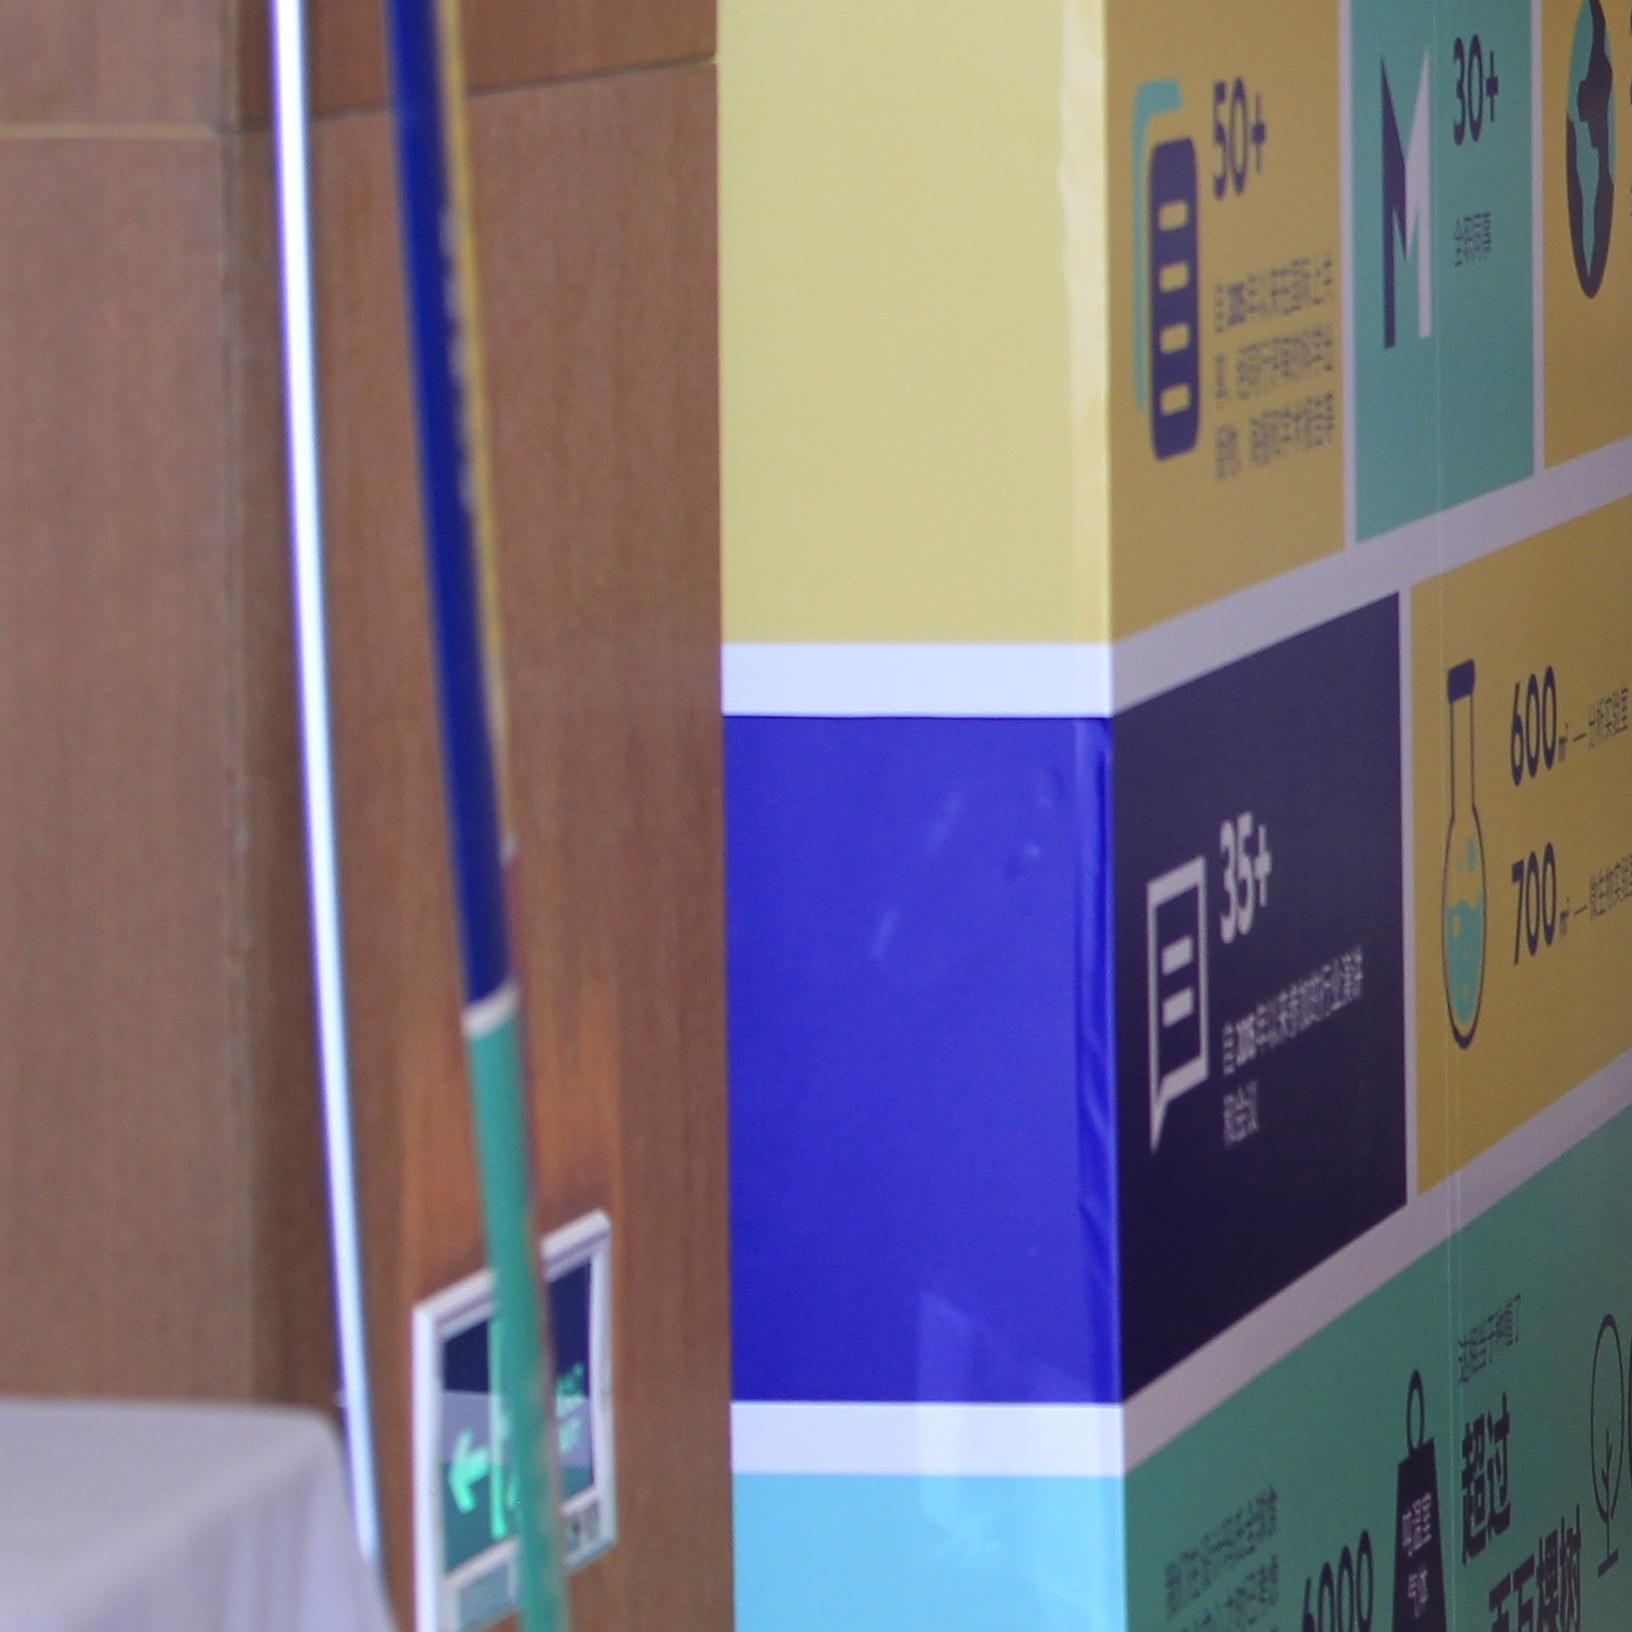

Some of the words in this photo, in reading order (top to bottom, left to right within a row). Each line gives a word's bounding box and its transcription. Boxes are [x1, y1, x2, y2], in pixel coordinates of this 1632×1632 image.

[1212, 75, 1266, 202] 50+
[1452, 34, 1499, 146] 30+
[1219, 811, 1272, 945] 35+
